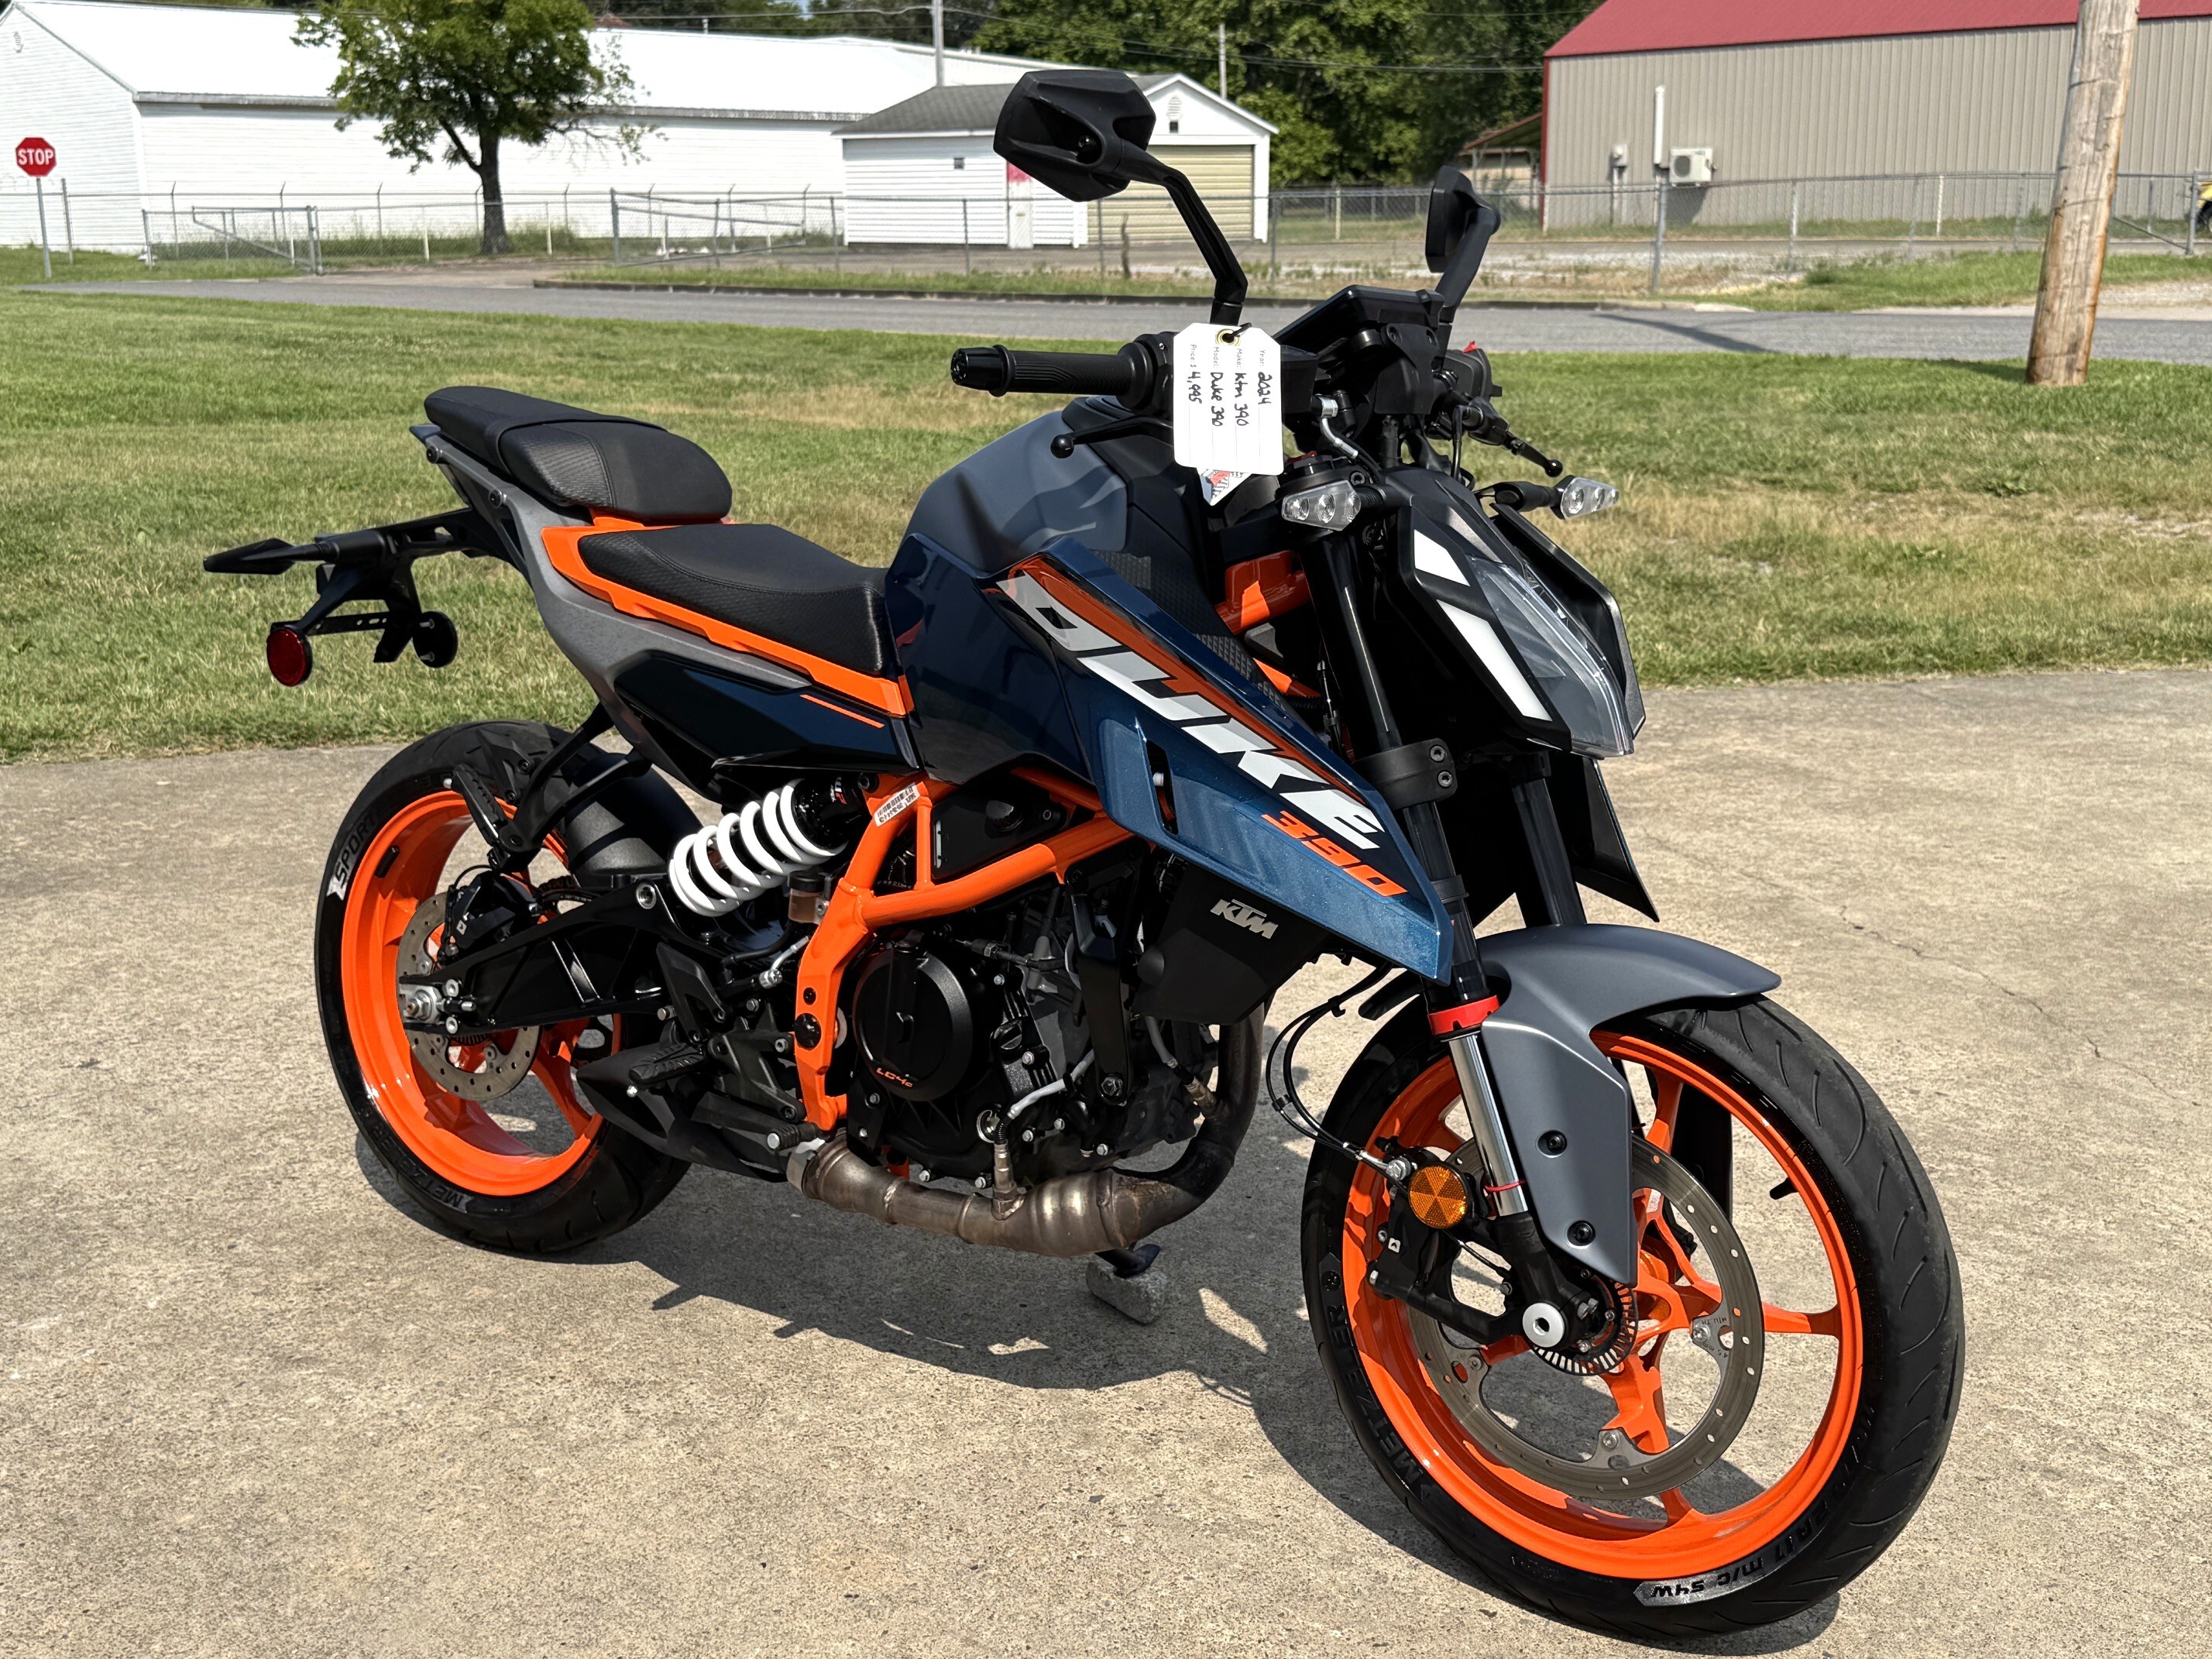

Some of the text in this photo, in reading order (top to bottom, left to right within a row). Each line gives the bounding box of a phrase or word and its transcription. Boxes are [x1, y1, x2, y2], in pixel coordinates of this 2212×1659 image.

[18, 148, 54, 165] STOP
[1187, 371, 1202, 404] 4,995
[1210, 372, 1224, 401] Duke
[1257, 371, 1273, 405] 2024
[1211, 405, 1224, 427] 390
[1234, 403, 1249, 427] 390
[996, 572, 1385, 850] DUKE
[1261, 810, 1408, 897] 390
[1210, 898, 1279, 939] KTM
